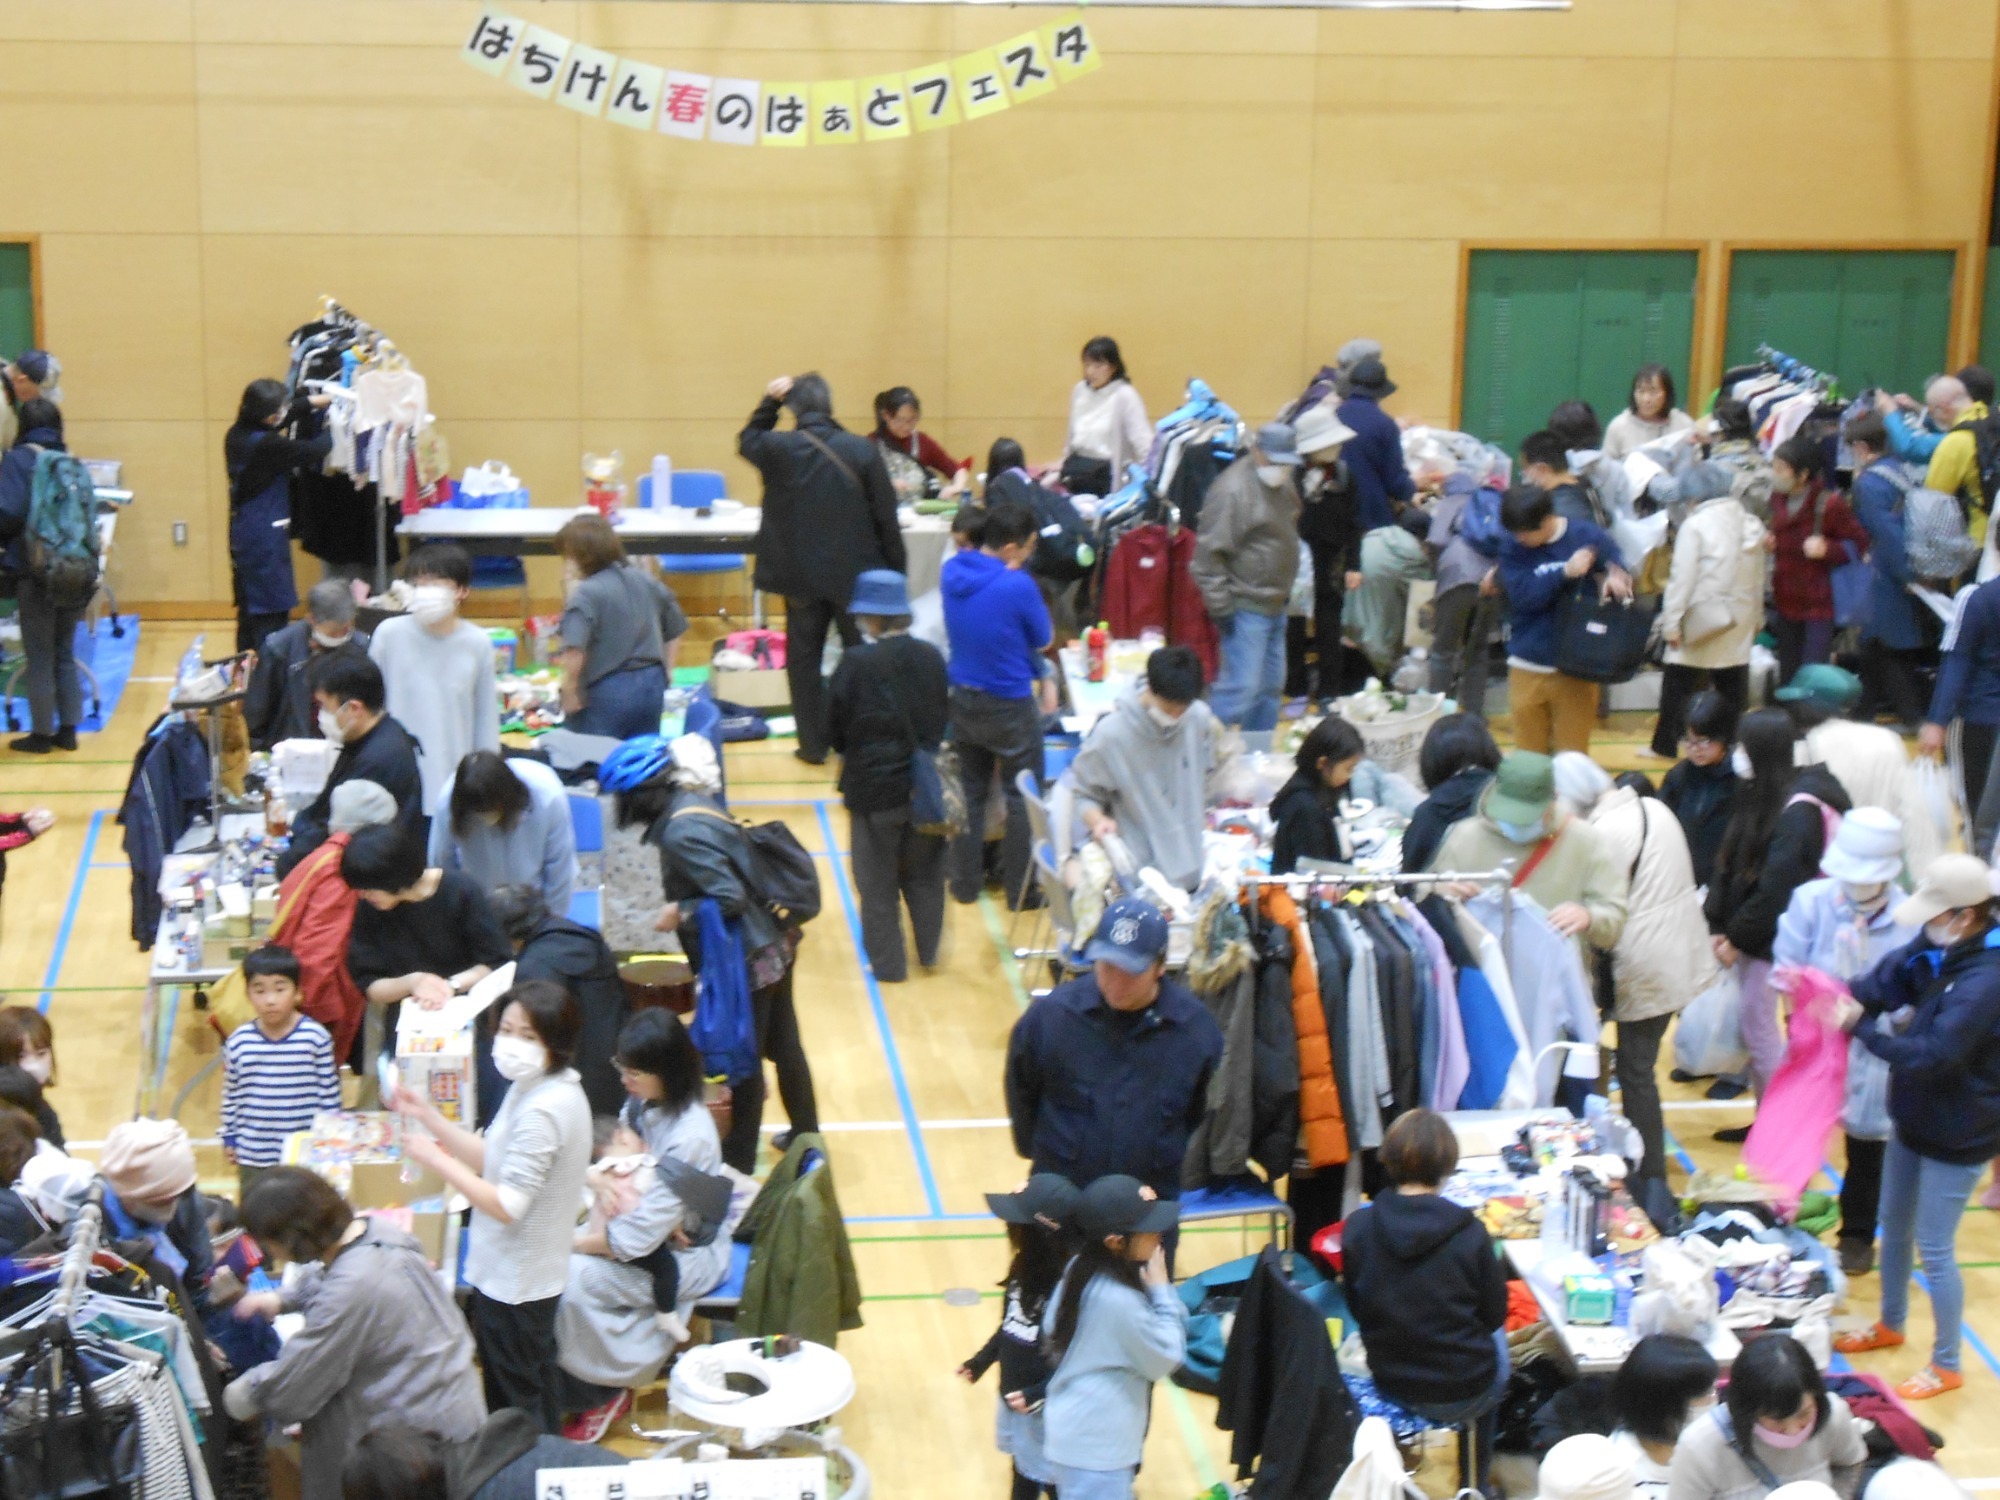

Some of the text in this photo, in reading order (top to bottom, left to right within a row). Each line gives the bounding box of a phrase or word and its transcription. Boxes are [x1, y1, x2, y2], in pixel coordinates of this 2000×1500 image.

[469, 15, 1089, 133] はちけん春のはぁとフェスタ
